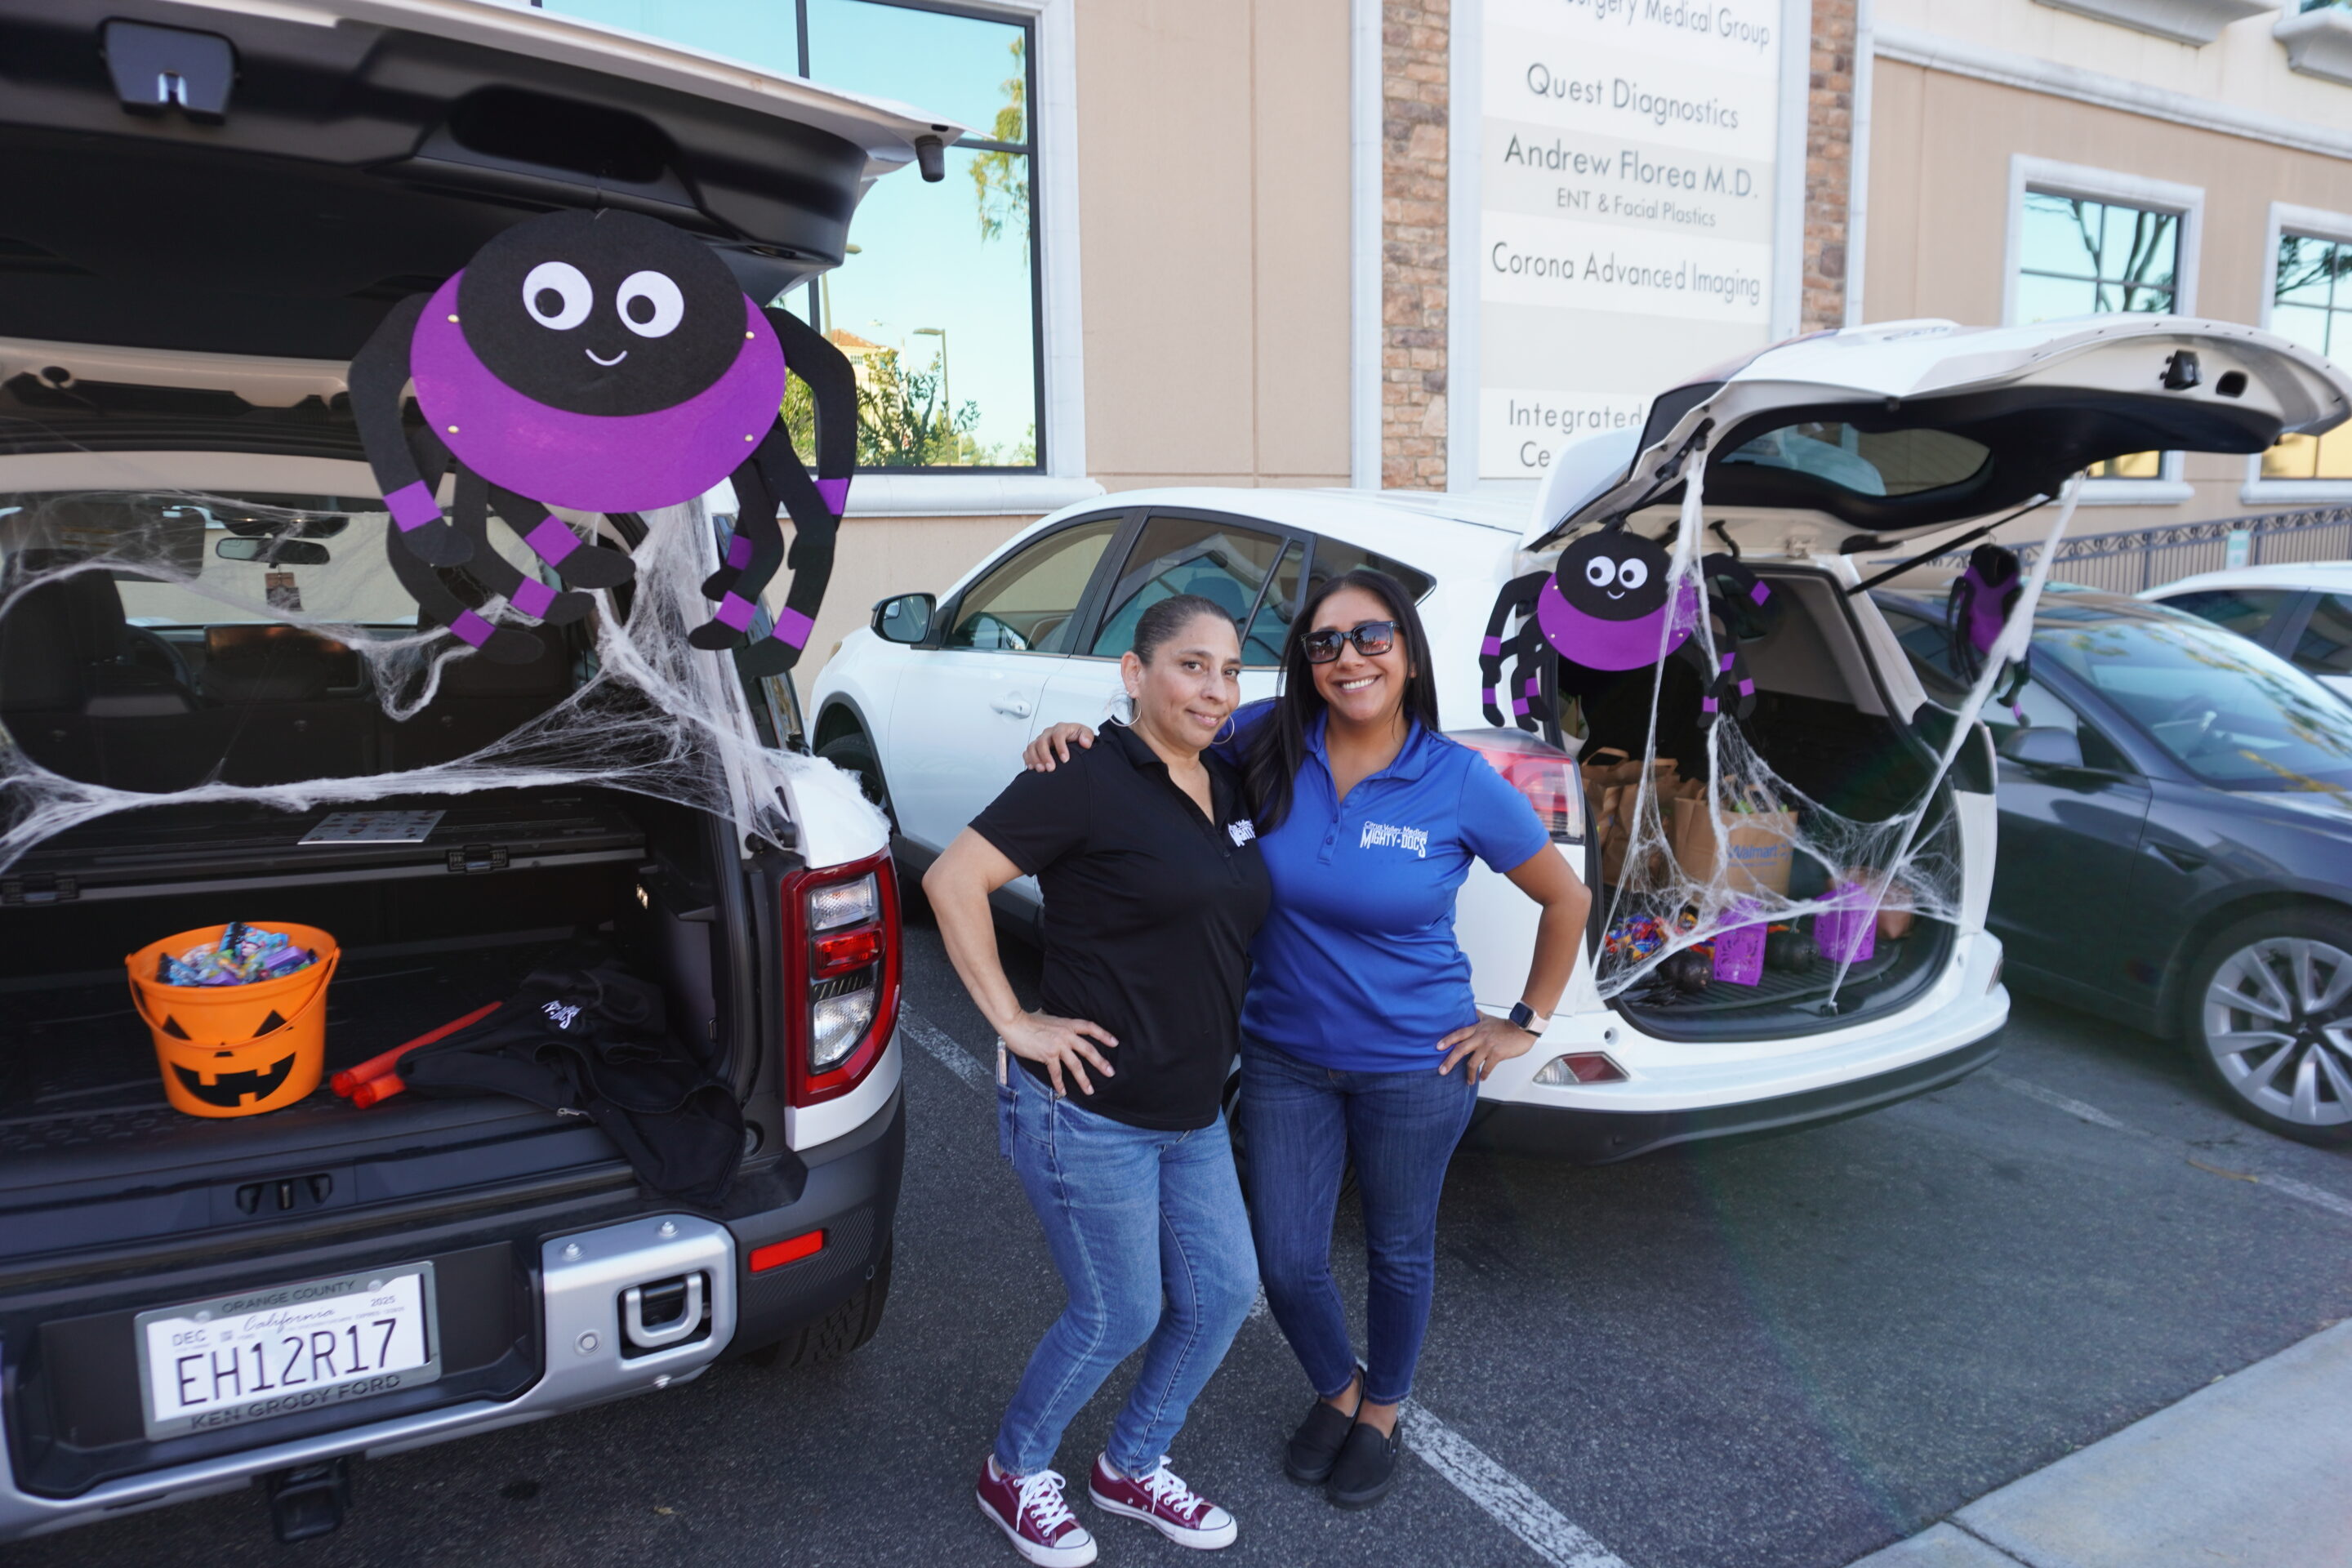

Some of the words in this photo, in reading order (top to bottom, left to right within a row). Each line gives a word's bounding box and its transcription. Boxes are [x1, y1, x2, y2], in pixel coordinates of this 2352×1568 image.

[1566, 0, 1637, 26] gery
[1645, 0, 1712, 33] Medical
[1718, 7, 1771, 53] Group
[1526, 62, 1603, 105] Quest
[1613, 78, 1739, 129] Diagnostics
[1504, 133, 1611, 176] Andrew
[1620, 150, 1696, 190] Florea
[1704, 165, 1758, 199] M.D.
[1557, 188, 1592, 210] ENT
[1597, 194, 1610, 213] &
[1615, 195, 1658, 220] Facial
[1663, 202, 1716, 228] Plastics
[1492, 242, 1575, 278] Corona
[1584, 252, 1686, 291] Advanced
[1693, 262, 1761, 305] Imaging
[1509, 399, 1642, 434] Integrated
[1520, 441, 1551, 467] Ce
[1384, 823, 1402, 834] Valley
[1403, 826, 1428, 838] Medical
[221, 1293, 289, 1314] ORANGE
[292, 1280, 357, 1301] COUNTY
[370, 1295, 396, 1307] 2025
[172, 1329, 207, 1347] DEC
[244, 1307, 336, 1334] California
[176, 1317, 398, 1406] EH12R17
[189, 1406, 240, 1431] KEN
[247, 1391, 330, 1419] GRODY
[336, 1374, 402, 1400] FORD
